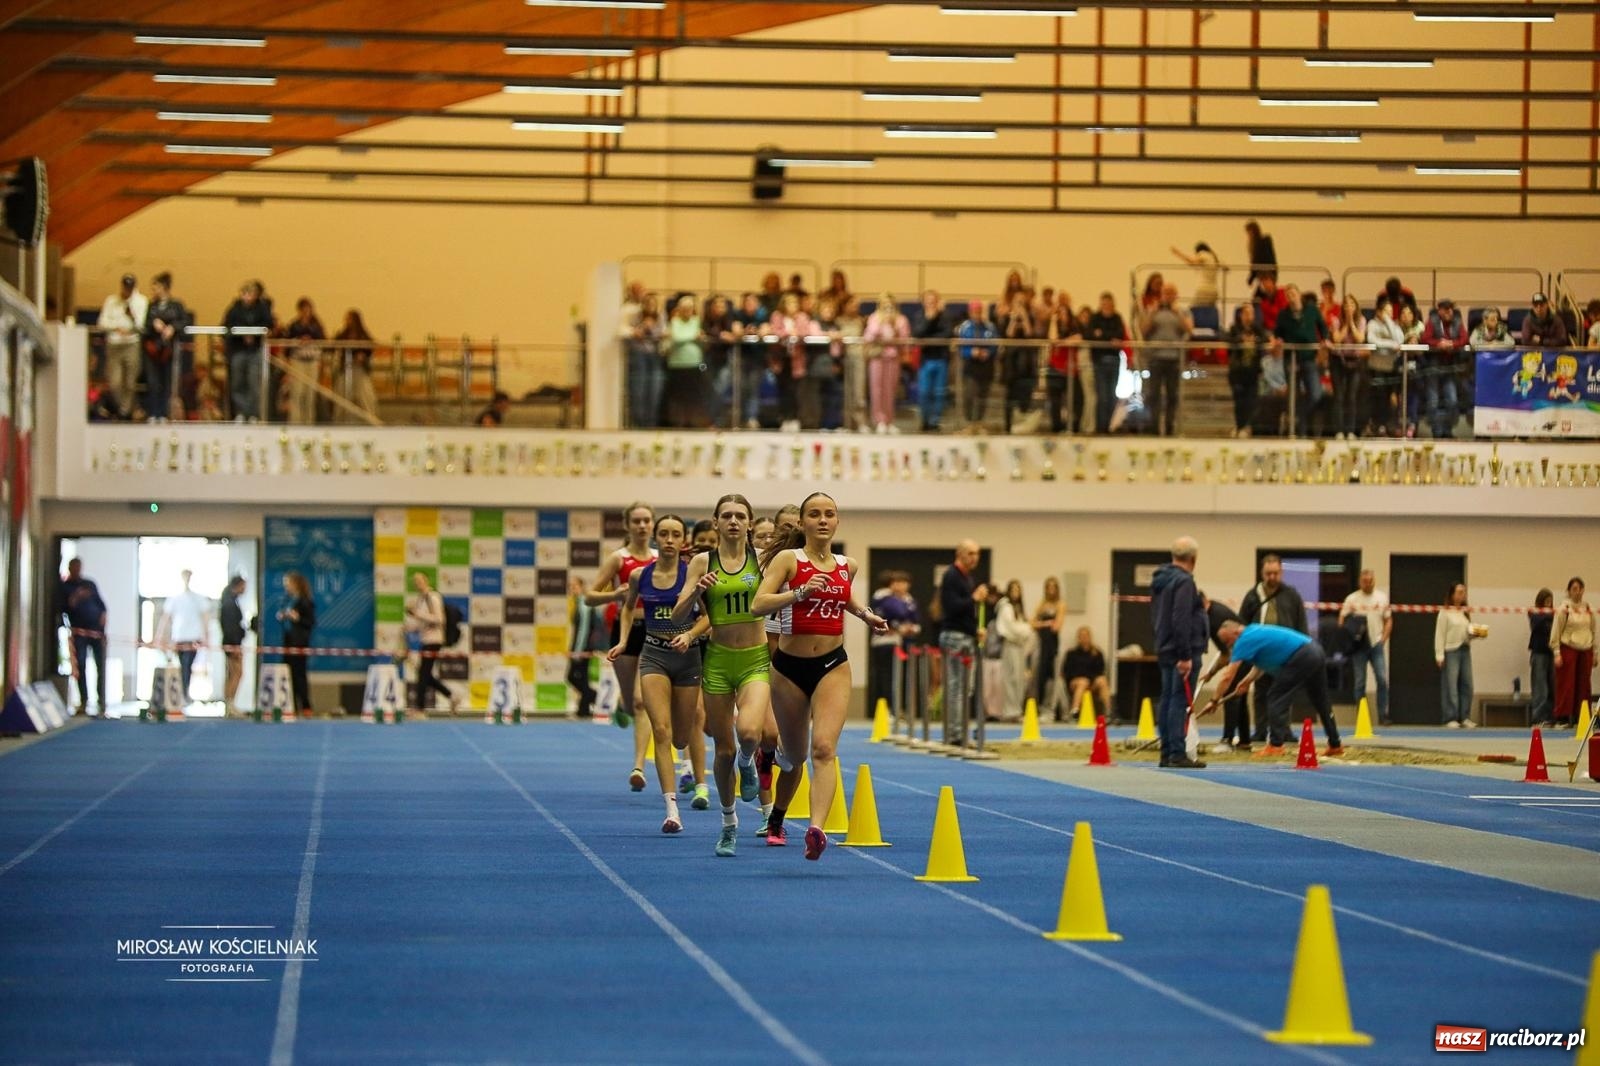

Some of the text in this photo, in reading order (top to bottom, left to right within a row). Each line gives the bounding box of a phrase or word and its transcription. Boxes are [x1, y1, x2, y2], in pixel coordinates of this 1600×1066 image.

[821, 585, 845, 595] AST
[724, 591, 750, 615] 111
[806, 598, 847, 619] 765
[383, 677, 396, 703] 4
[494, 677, 508, 709] 3
[600, 679, 612, 710] 2
